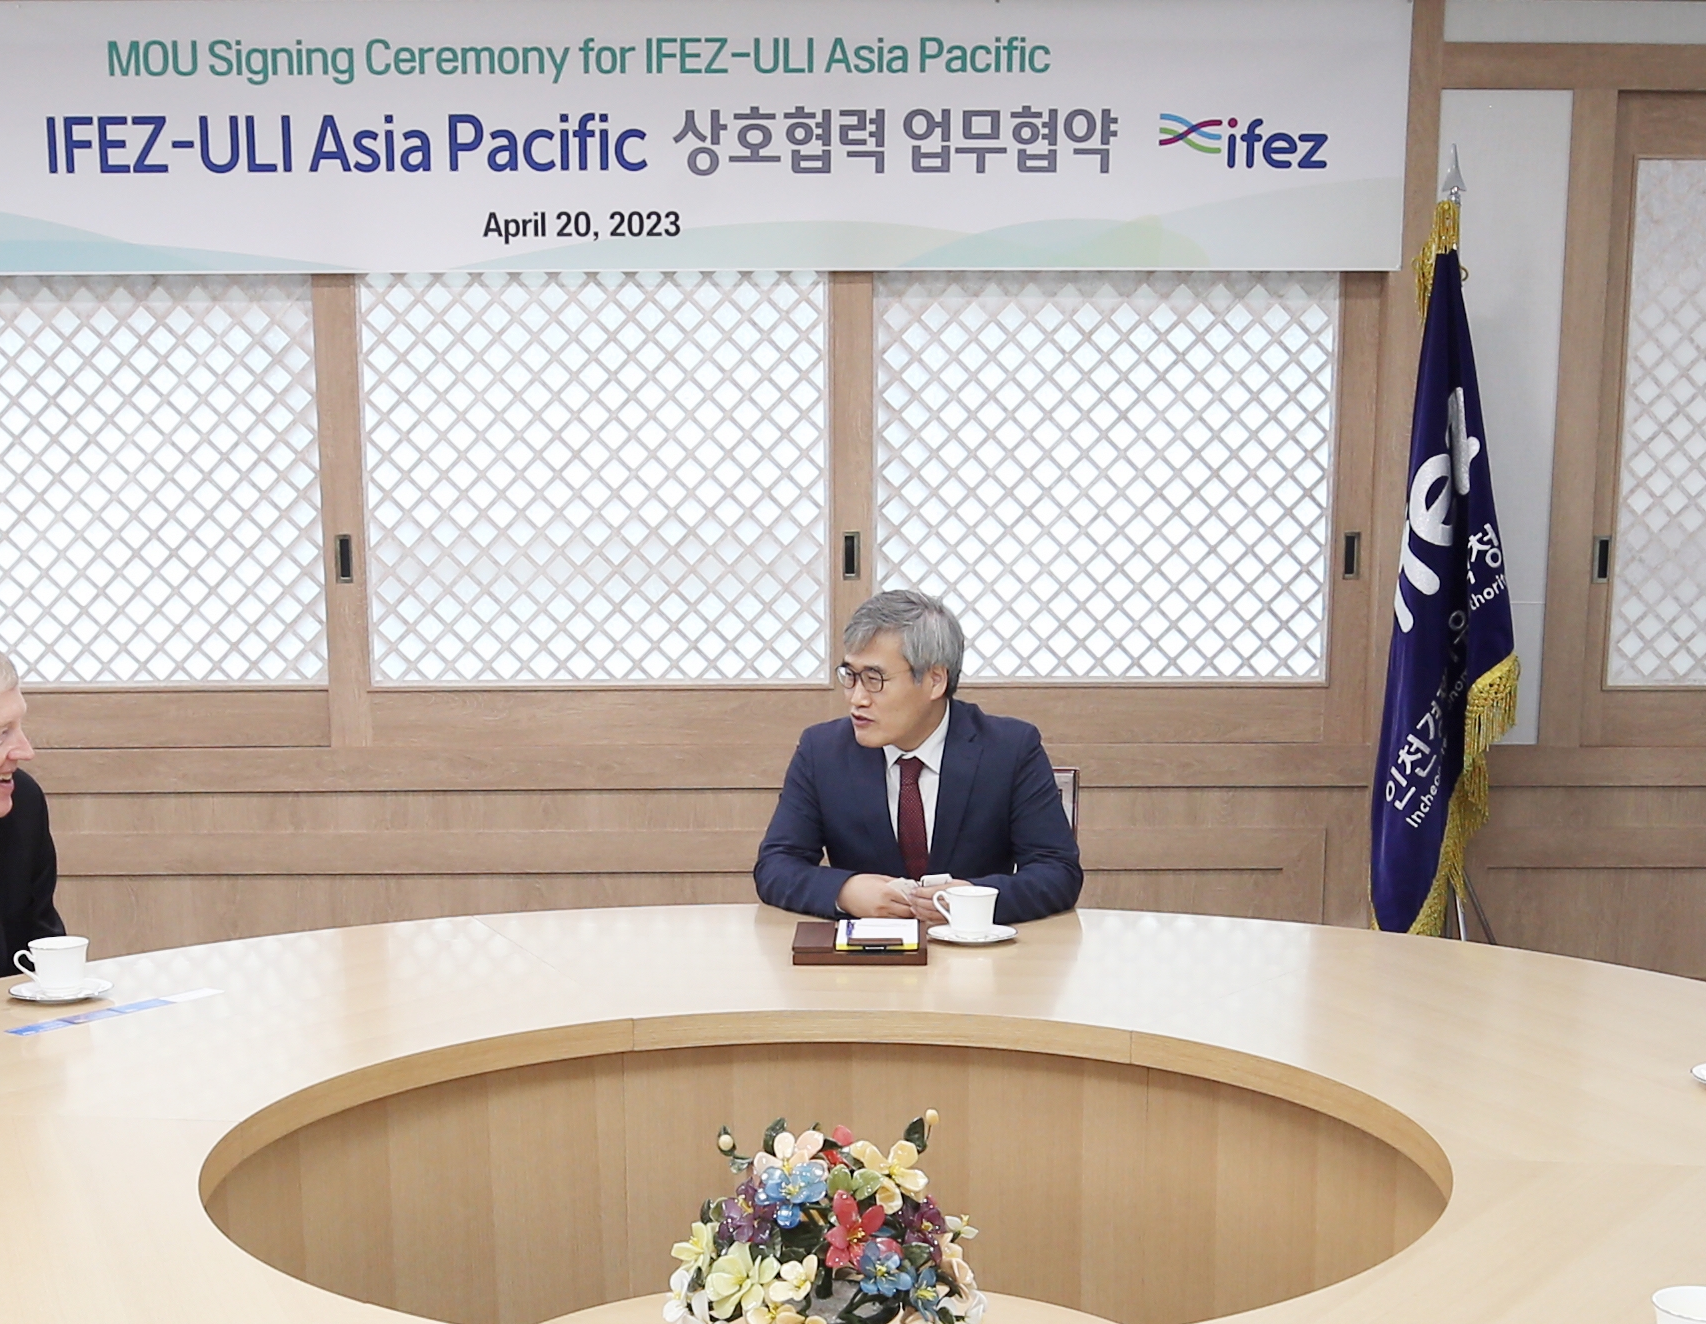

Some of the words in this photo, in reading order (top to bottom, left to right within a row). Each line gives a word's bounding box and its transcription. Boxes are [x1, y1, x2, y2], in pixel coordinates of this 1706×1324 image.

[107, 39, 199, 77] MOU
[208, 39, 355, 86] Signing
[365, 38, 571, 84] Ceremony
[578, 37, 637, 75] for
[645, 37, 815, 74] IFEZ-ULI
[824, 37, 909, 74] Asia
[919, 36, 1052, 74] Pacific
[45, 114, 293, 175] IFEZ-ULI
[308, 113, 432, 174] Asia
[447, 112, 649, 173] Pacific
[672, 105, 886, 177] 상호협력
[902, 105, 1119, 174] 업무협약
[1226, 117, 1329, 170] ifez
[482, 211, 547, 245] April
[555, 210, 599, 242] 20,
[609, 210, 681, 238] 2023
